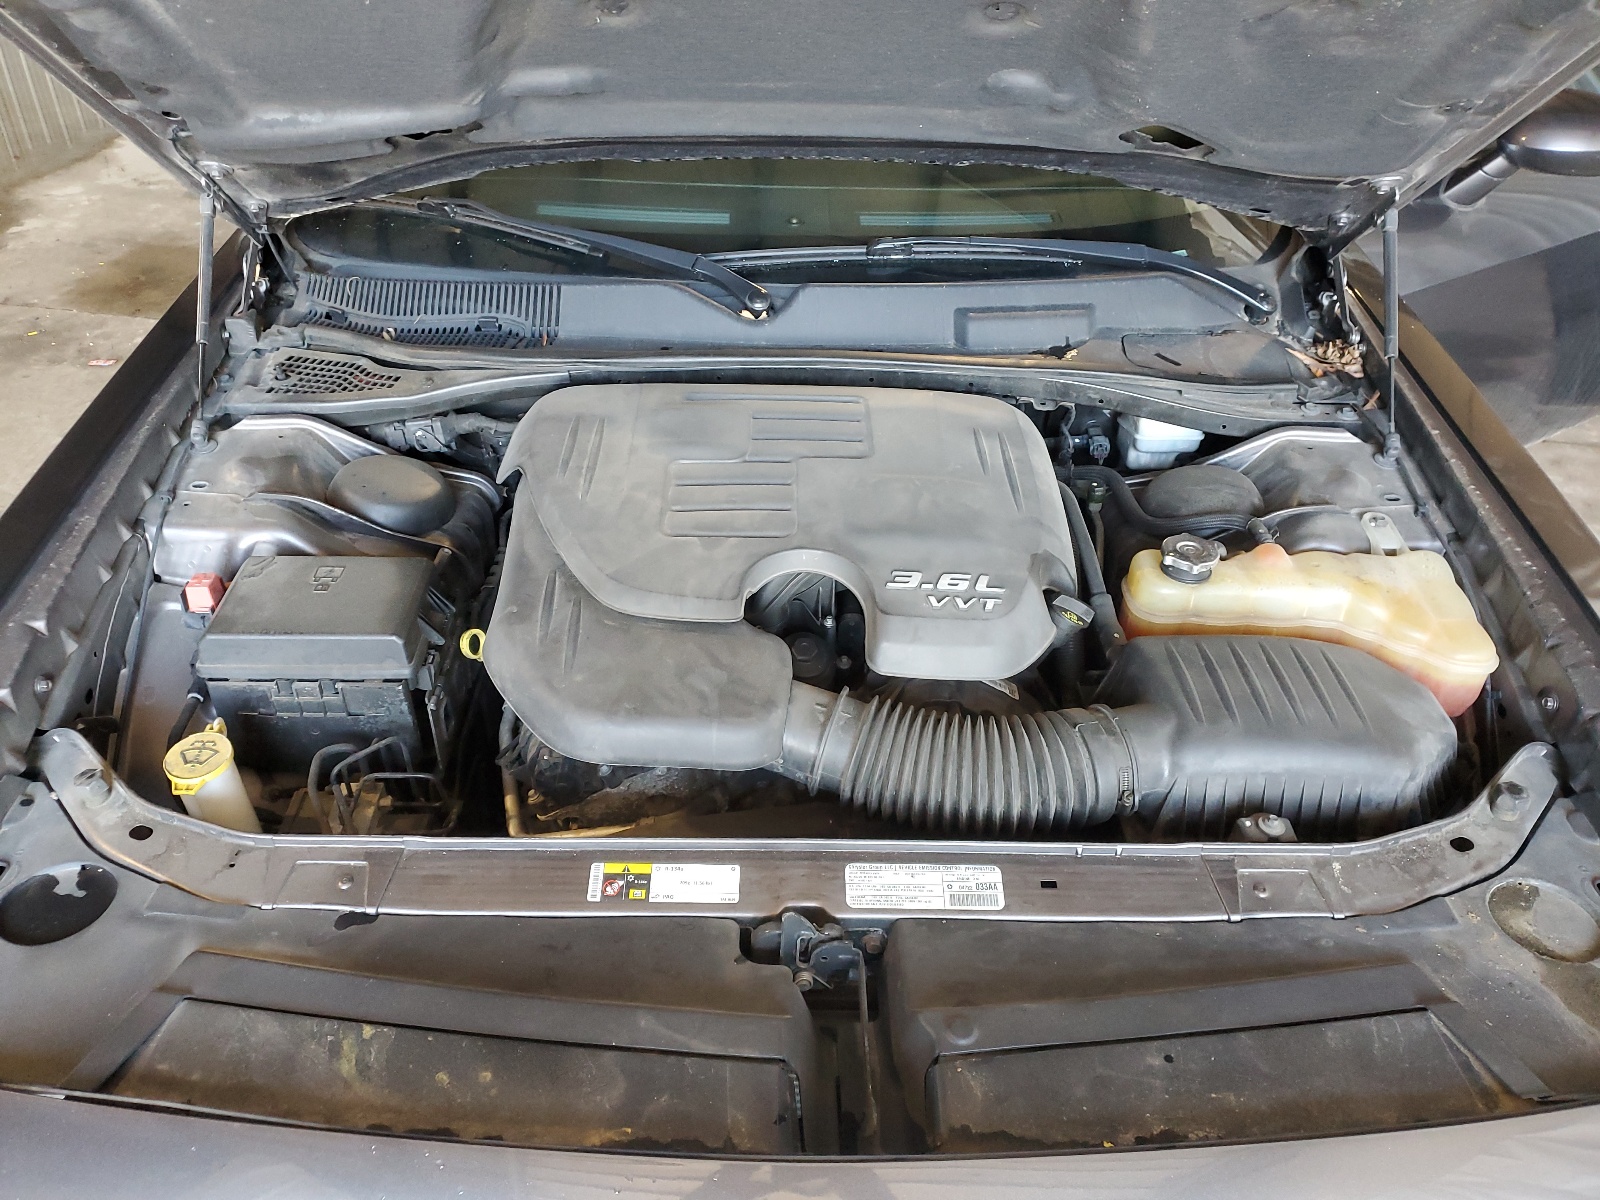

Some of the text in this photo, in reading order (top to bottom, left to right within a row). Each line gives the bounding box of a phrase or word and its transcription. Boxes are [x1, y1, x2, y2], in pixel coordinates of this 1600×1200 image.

[885, 570, 1006, 594] 3.6L
[926, 595, 1003, 612] VVT
[975, 882, 999, 891] 033AA
